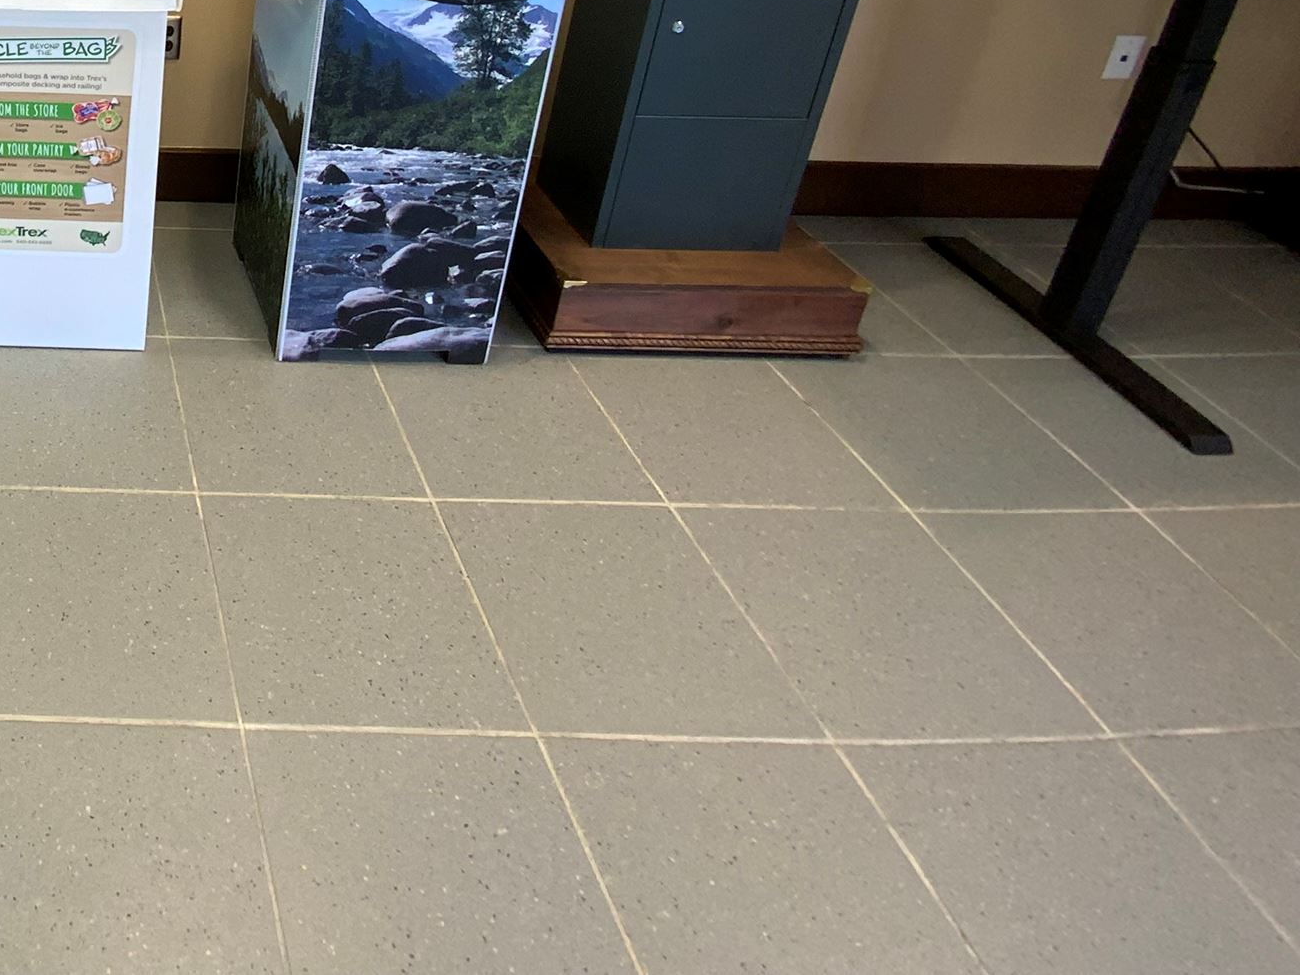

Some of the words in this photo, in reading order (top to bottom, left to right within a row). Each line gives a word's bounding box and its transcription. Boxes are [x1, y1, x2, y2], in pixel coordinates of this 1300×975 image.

[62, 41, 103, 56] BAG
[31, 81, 61, 89] decking
[15, 102, 30, 117] THE
[33, 103, 59, 118] STORE
[6, 142, 30, 156] YOUR
[32, 143, 65, 157] PANTRY
[22, 182, 47, 196] FRONT
[51, 183, 74, 197] DOOR
